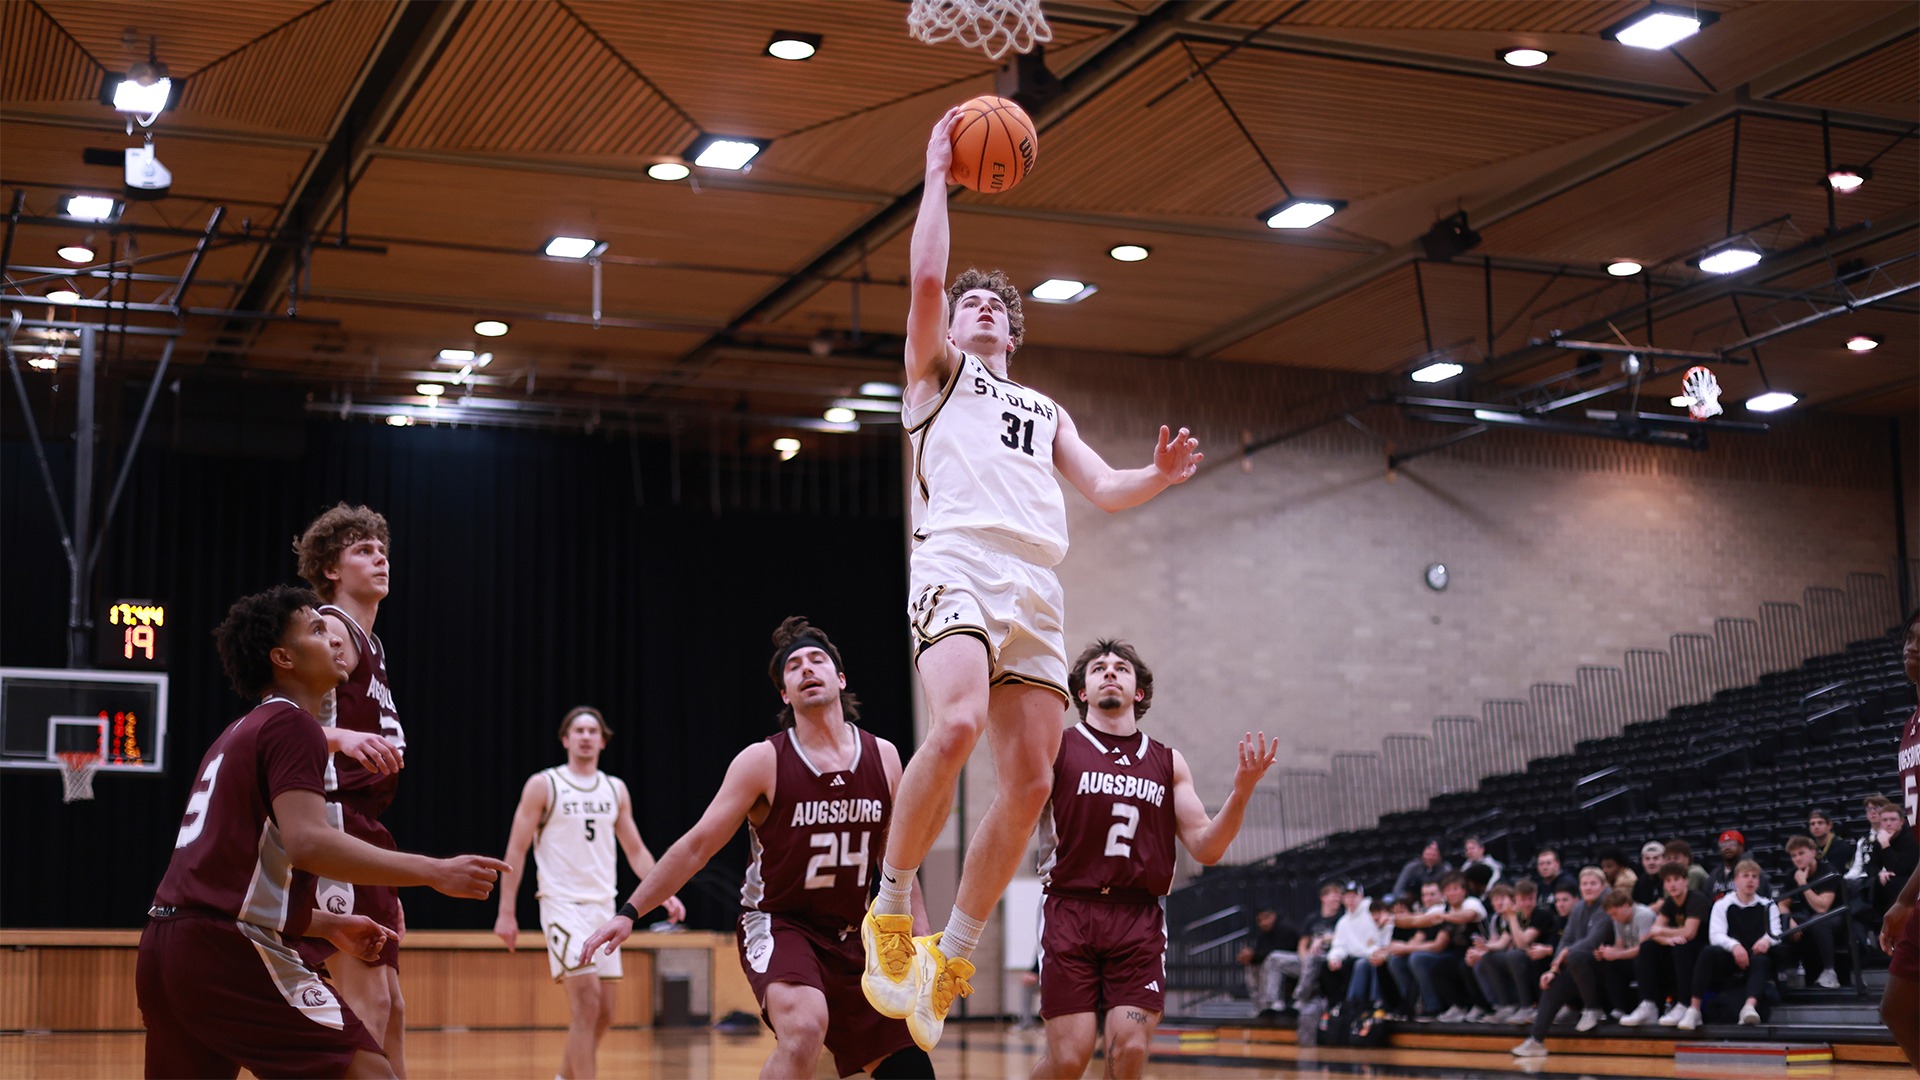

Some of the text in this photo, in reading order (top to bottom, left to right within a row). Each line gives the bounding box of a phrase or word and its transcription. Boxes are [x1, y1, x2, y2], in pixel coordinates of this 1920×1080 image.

[1000, 411, 1034, 457] 31
[124, 624, 154, 660] 19
[1077, 771, 1166, 808] AUGSBURG
[1904, 774, 1919, 828] 5
[585, 818, 596, 842] 5
[790, 798, 883, 827] AUGSBURG
[1104, 802, 1140, 859] 2
[804, 831, 871, 890] 24
